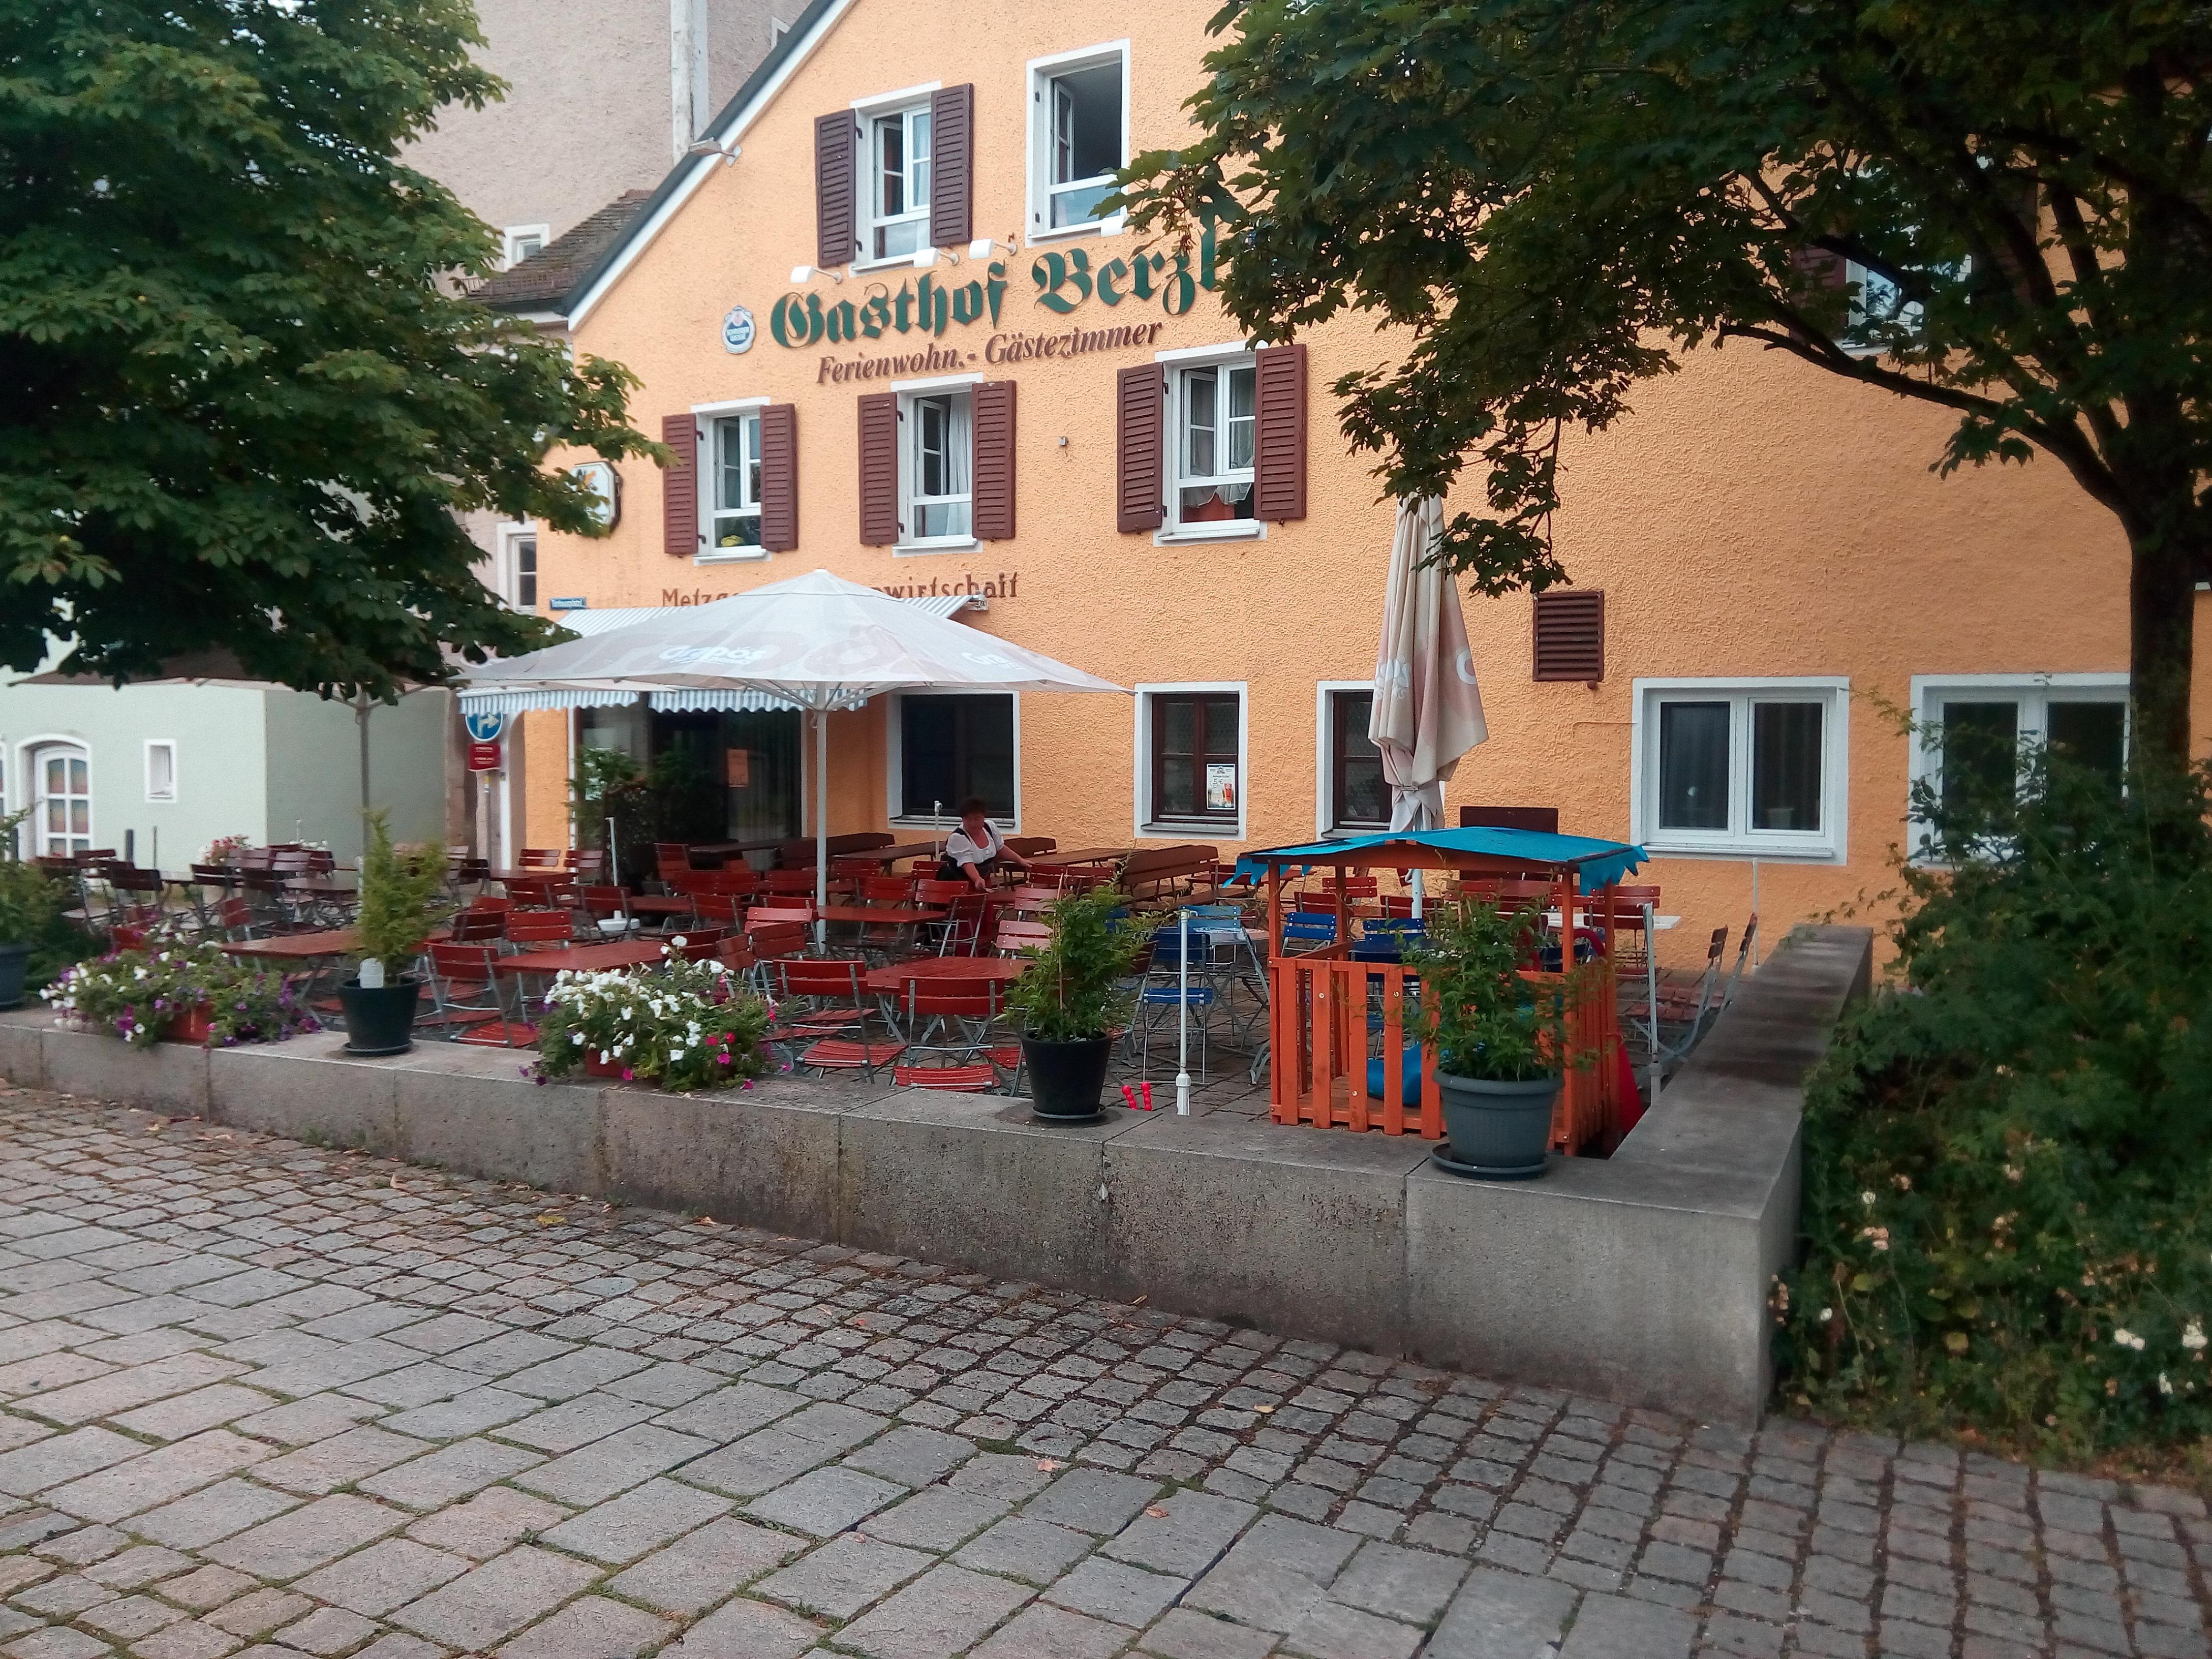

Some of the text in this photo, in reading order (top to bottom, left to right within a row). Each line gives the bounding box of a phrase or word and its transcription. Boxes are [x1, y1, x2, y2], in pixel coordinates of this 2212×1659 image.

[771, 259, 1008, 349] Gasthof
[985, 322, 1162, 364] Gästezimmer
[662, 588, 739, 607] Metz
